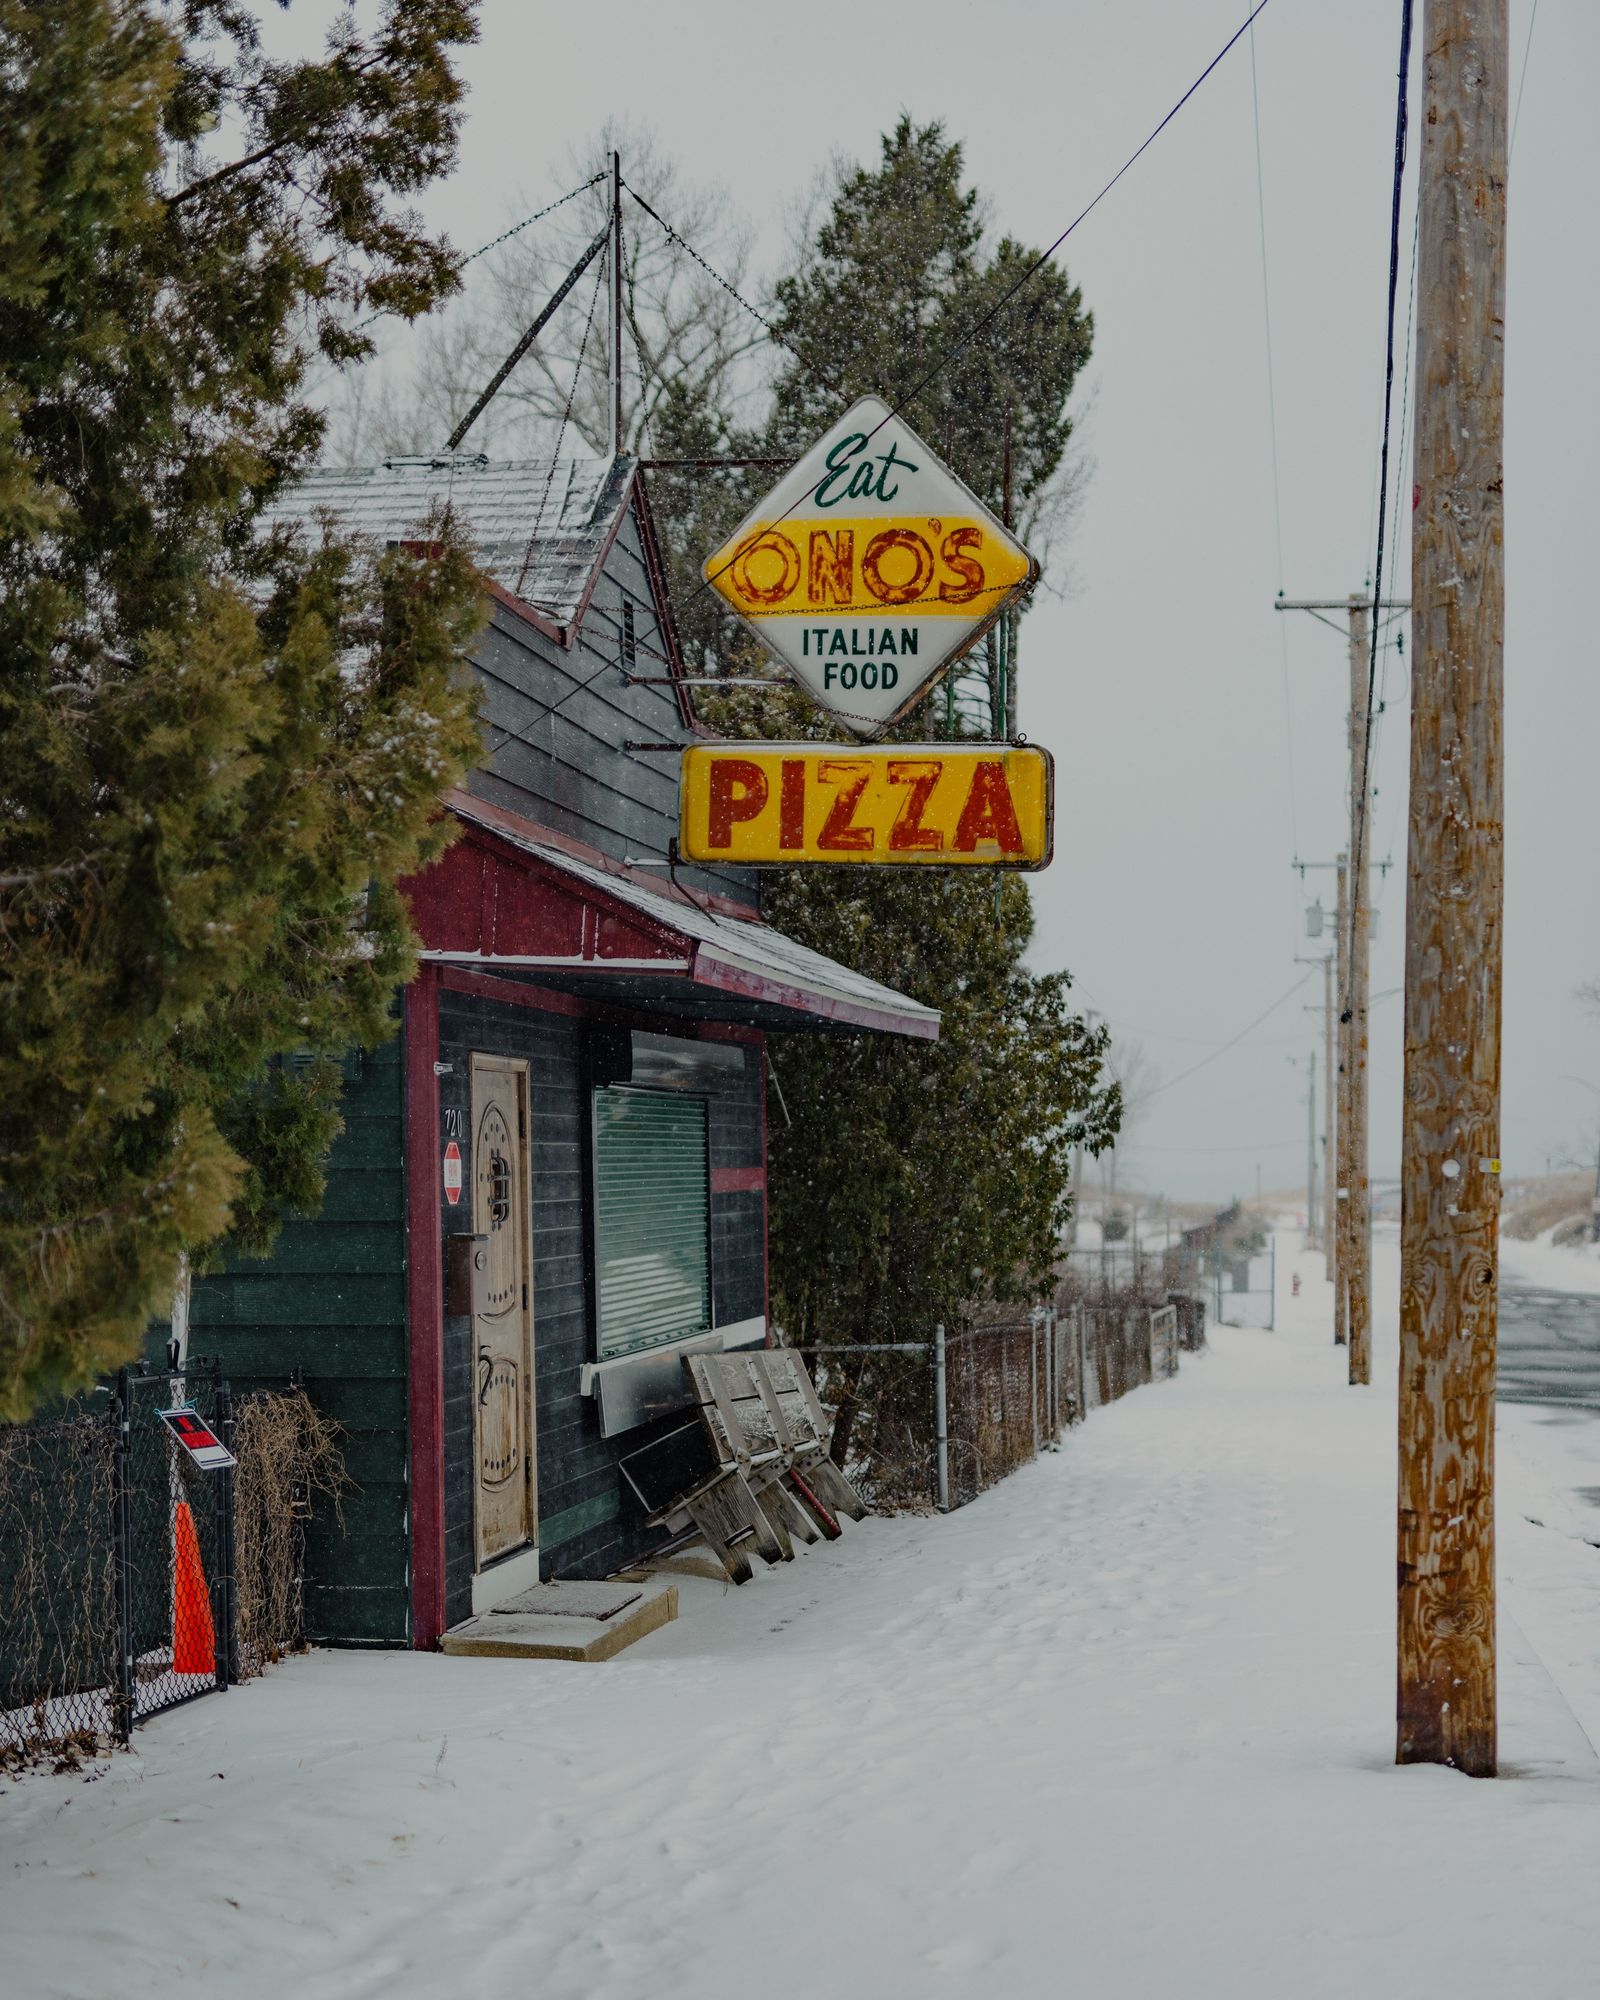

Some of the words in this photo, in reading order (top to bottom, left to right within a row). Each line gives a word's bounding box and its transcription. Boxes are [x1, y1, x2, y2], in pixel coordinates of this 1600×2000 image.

[814, 432, 919, 507] Eat
[731, 518, 986, 606] ONO'S
[803, 627, 919, 656] ITALIAN
[824, 662, 899, 690] FOOD
[708, 759, 1024, 854] PIZZA
[445, 1108, 462, 1138] 720
